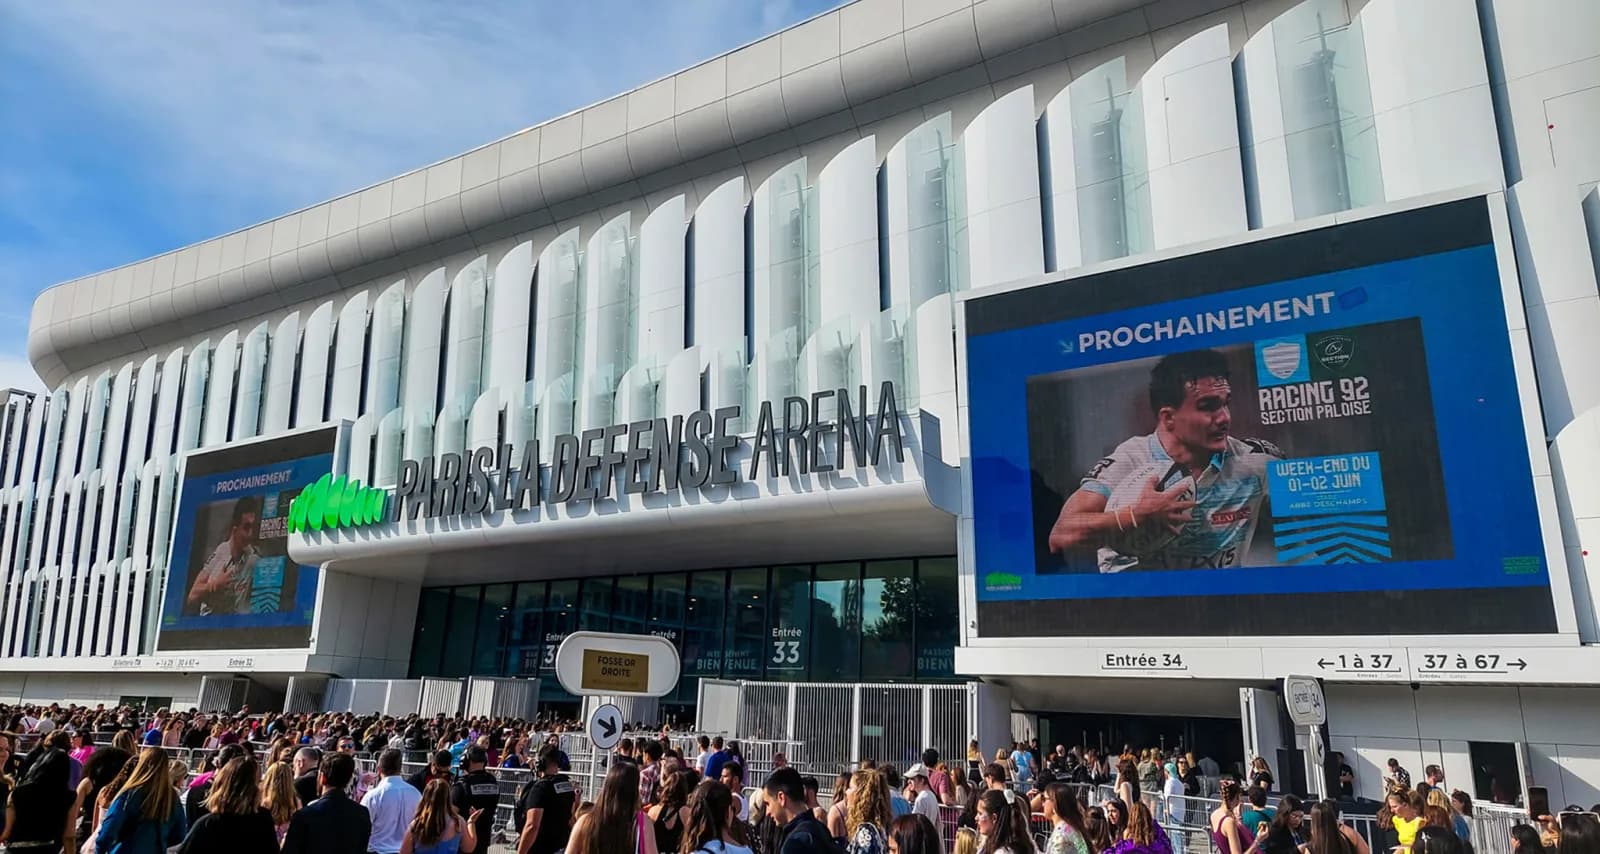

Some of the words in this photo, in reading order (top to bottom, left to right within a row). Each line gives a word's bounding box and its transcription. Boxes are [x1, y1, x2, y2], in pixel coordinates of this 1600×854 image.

[1078, 291, 1336, 353] PROCHAINEMENT
[1258, 381, 1335, 411] RACING
[1339, 376, 1370, 402] 92
[1261, 406, 1314, 425] SECTION
[1316, 400, 1372, 420] PALOISE
[392, 446, 494, 523] PARIS
[494, 439, 541, 511] LA
[550, 405, 741, 503] DEFENSE
[749, 380, 905, 480] ARENA
[1275, 457, 1349, 477] WEEK-END
[1352, 455, 1371, 472] DU
[216, 470, 292, 493] PROCHAINEMENT
[1288, 475, 1329, 492] 01-02
[1332, 472, 1362, 488] JUIN
[772, 627, 802, 638] Entrée
[544, 644, 560, 664] 3
[597, 655, 624, 667] FOSSE
[624, 658, 636, 668] OR
[772, 641, 800, 664] 33
[1105, 652, 1157, 667] Entrée
[1162, 653, 1182, 667] 34
[1338, 654, 1347, 669] 1
[1352, 653, 1364, 669] à
[1370, 654, 1393, 669] 37
[1423, 654, 1447, 669] 37
[1455, 653, 1468, 669] à
[1474, 654, 1501, 670] 67
[601, 667, 631, 678] DROITE
[1311, 692, 1321, 708] 34
